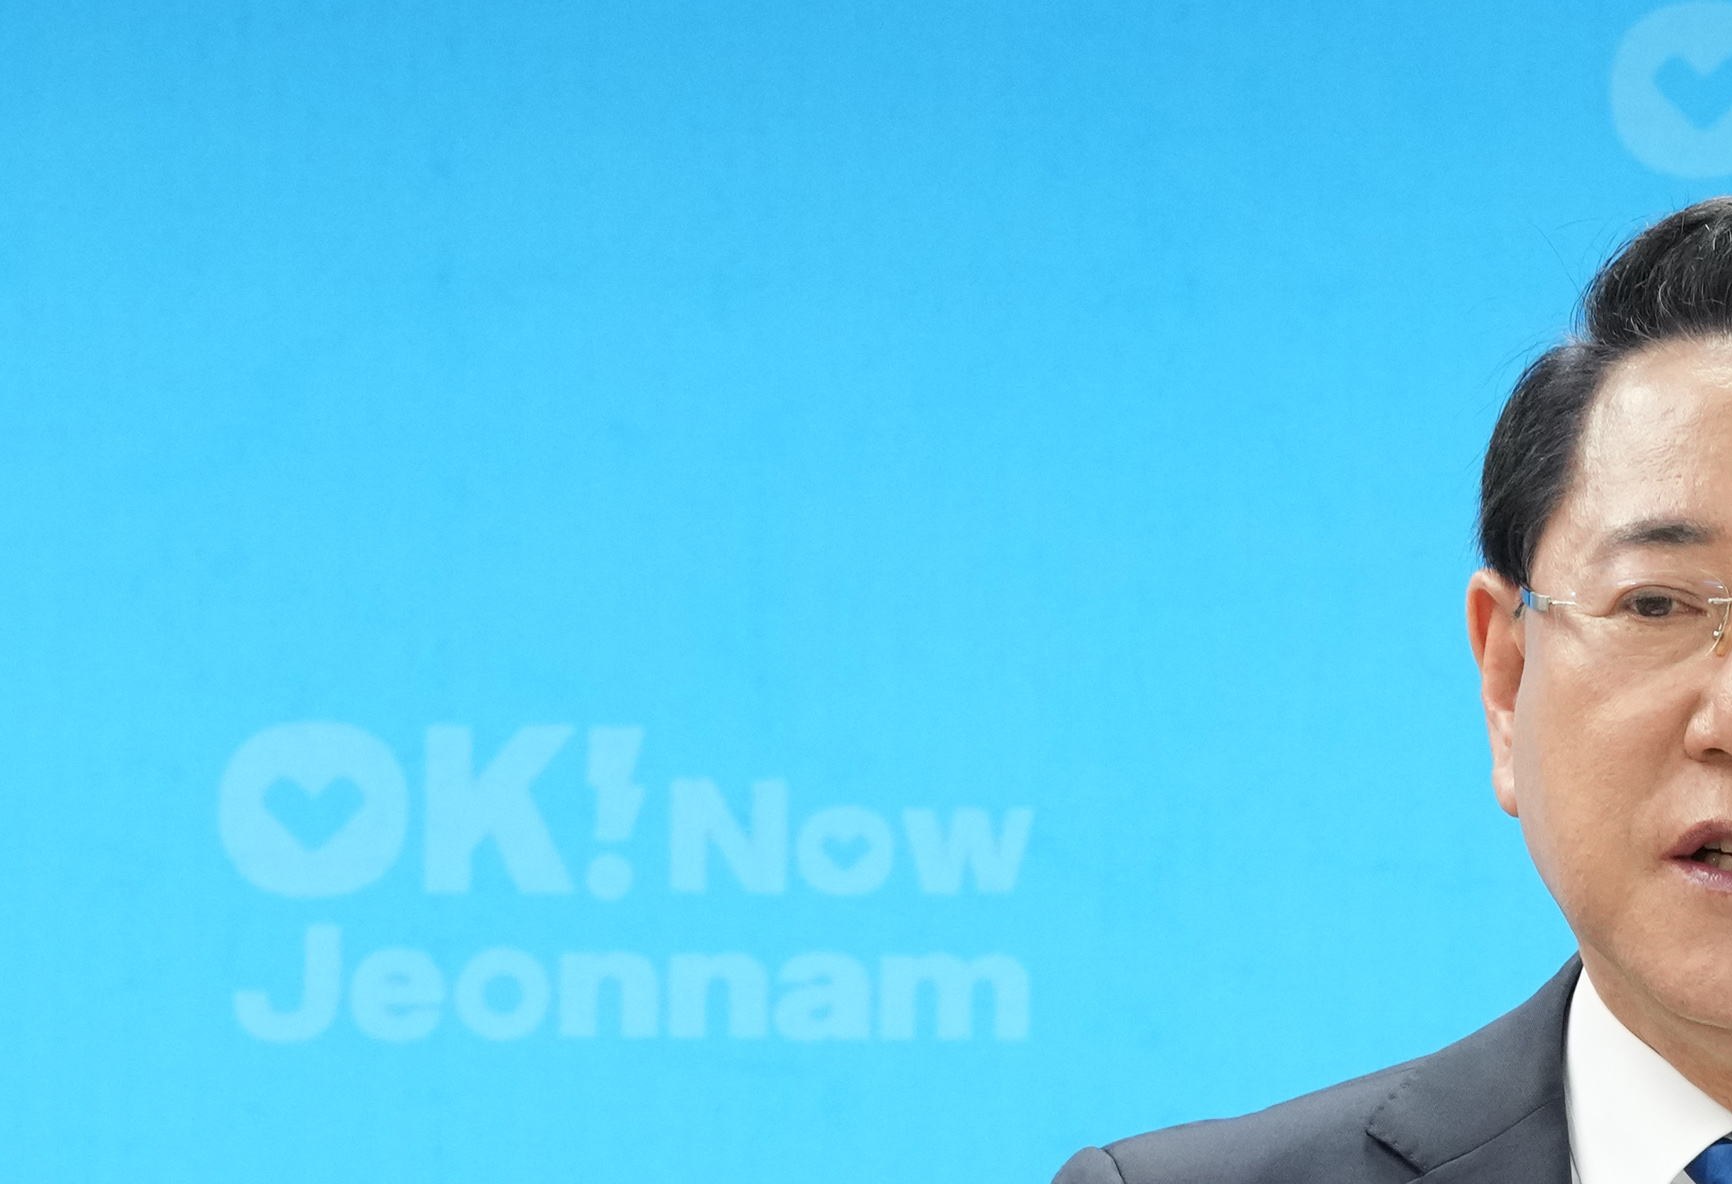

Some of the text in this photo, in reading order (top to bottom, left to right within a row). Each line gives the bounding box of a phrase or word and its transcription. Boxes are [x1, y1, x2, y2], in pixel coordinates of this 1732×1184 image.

[217, 720, 1036, 900] OK! Now
[233, 924, 1032, 1043] Jeonnam
